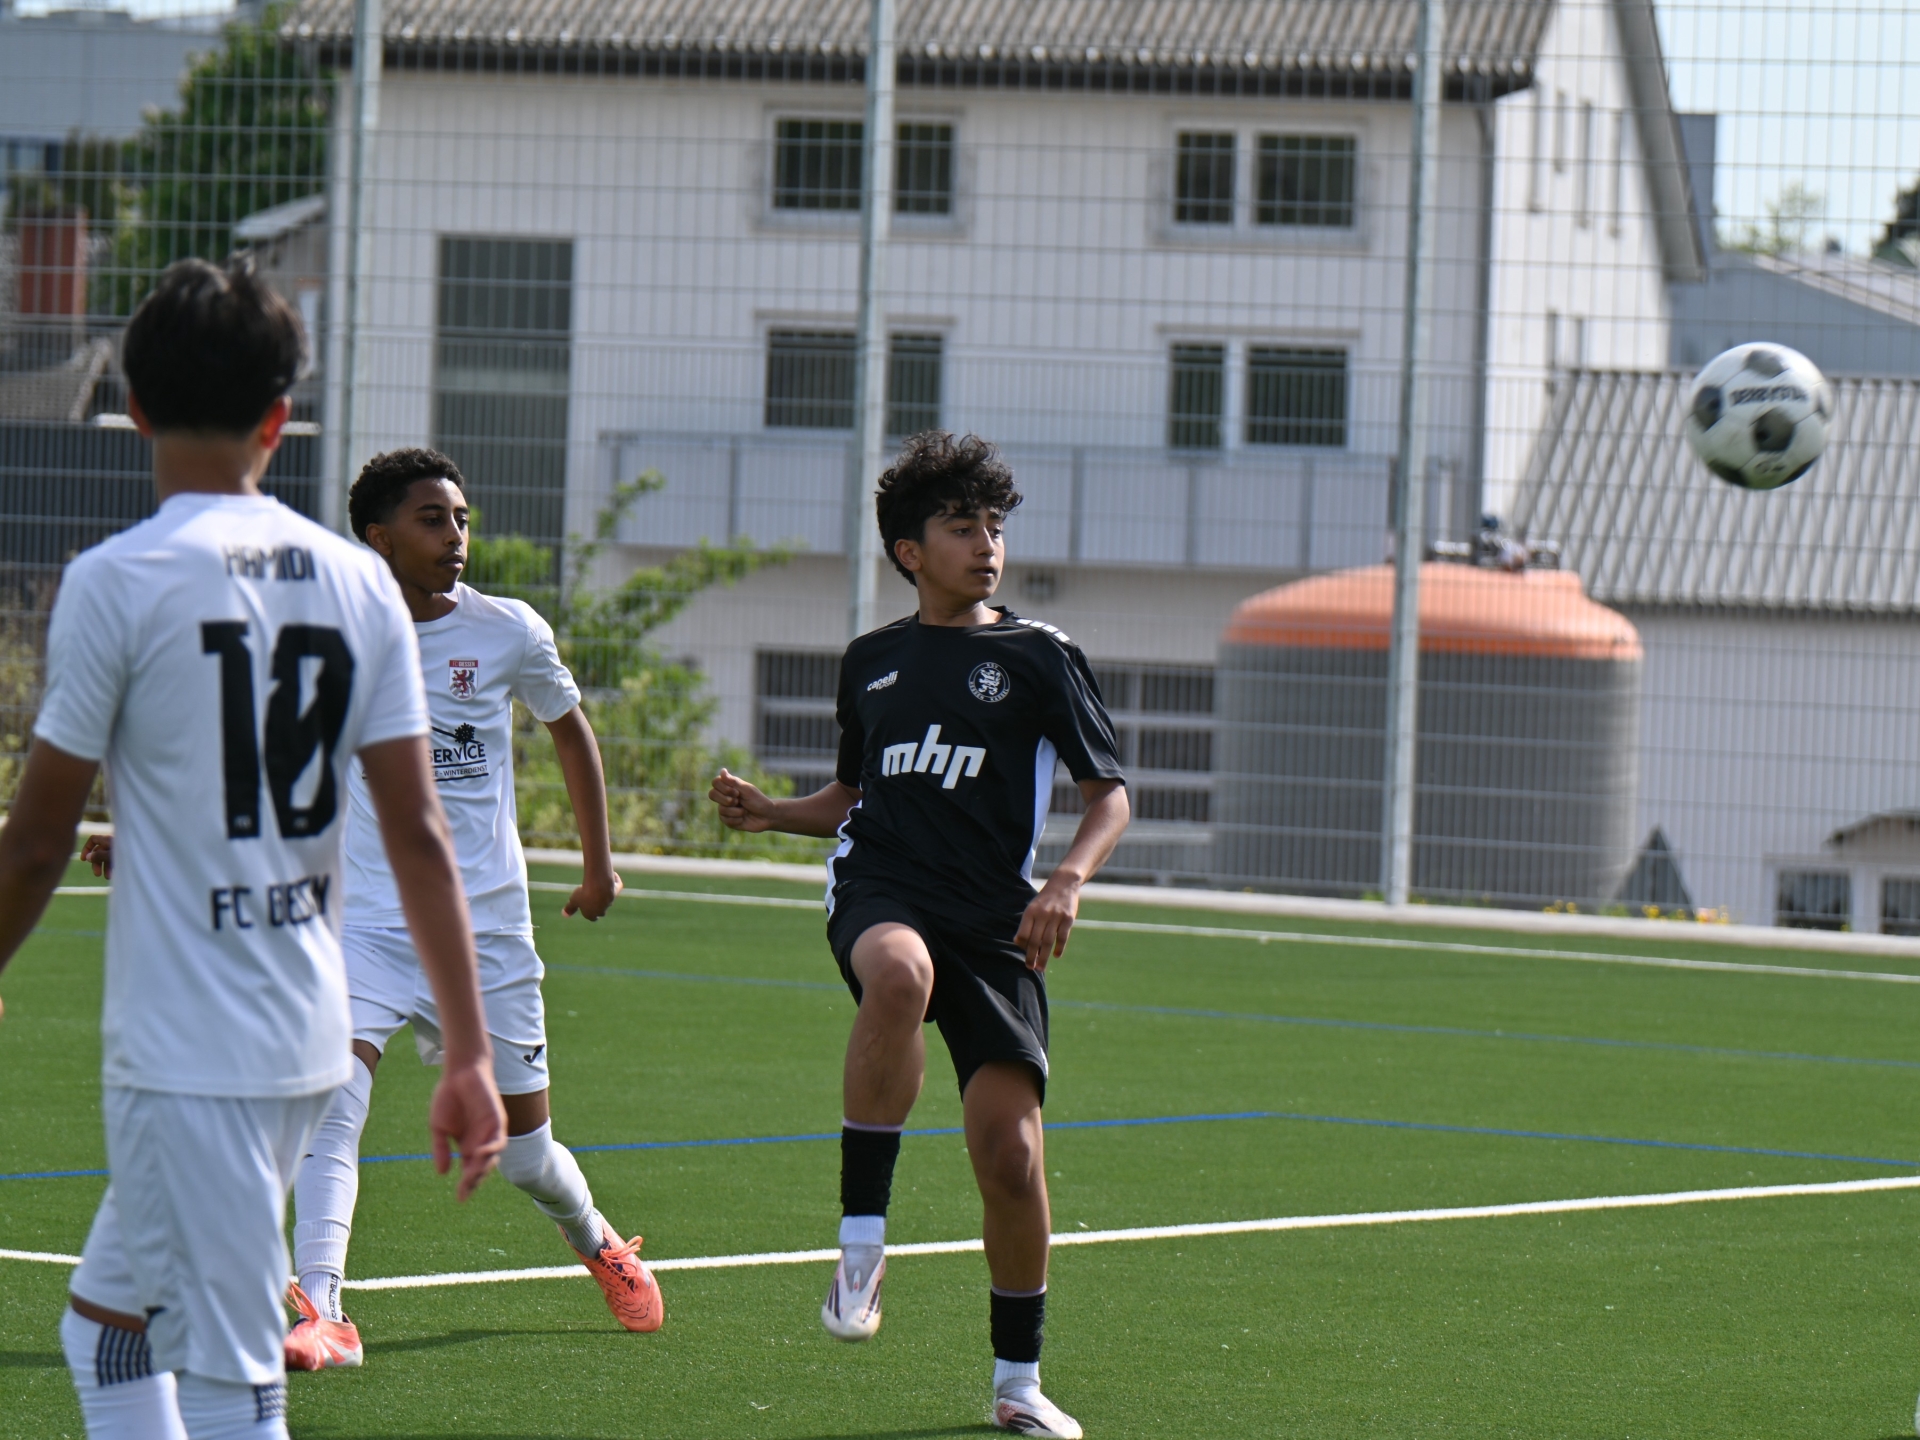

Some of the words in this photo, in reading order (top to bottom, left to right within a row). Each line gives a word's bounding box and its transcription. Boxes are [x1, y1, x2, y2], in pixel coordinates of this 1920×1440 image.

[867, 670, 899, 691] capelli
[201, 620, 355, 840] 10
[443, 765, 488, 777] WINTERDIENST
[882, 724, 987, 789] mhp
[211, 887, 253, 930] FC
